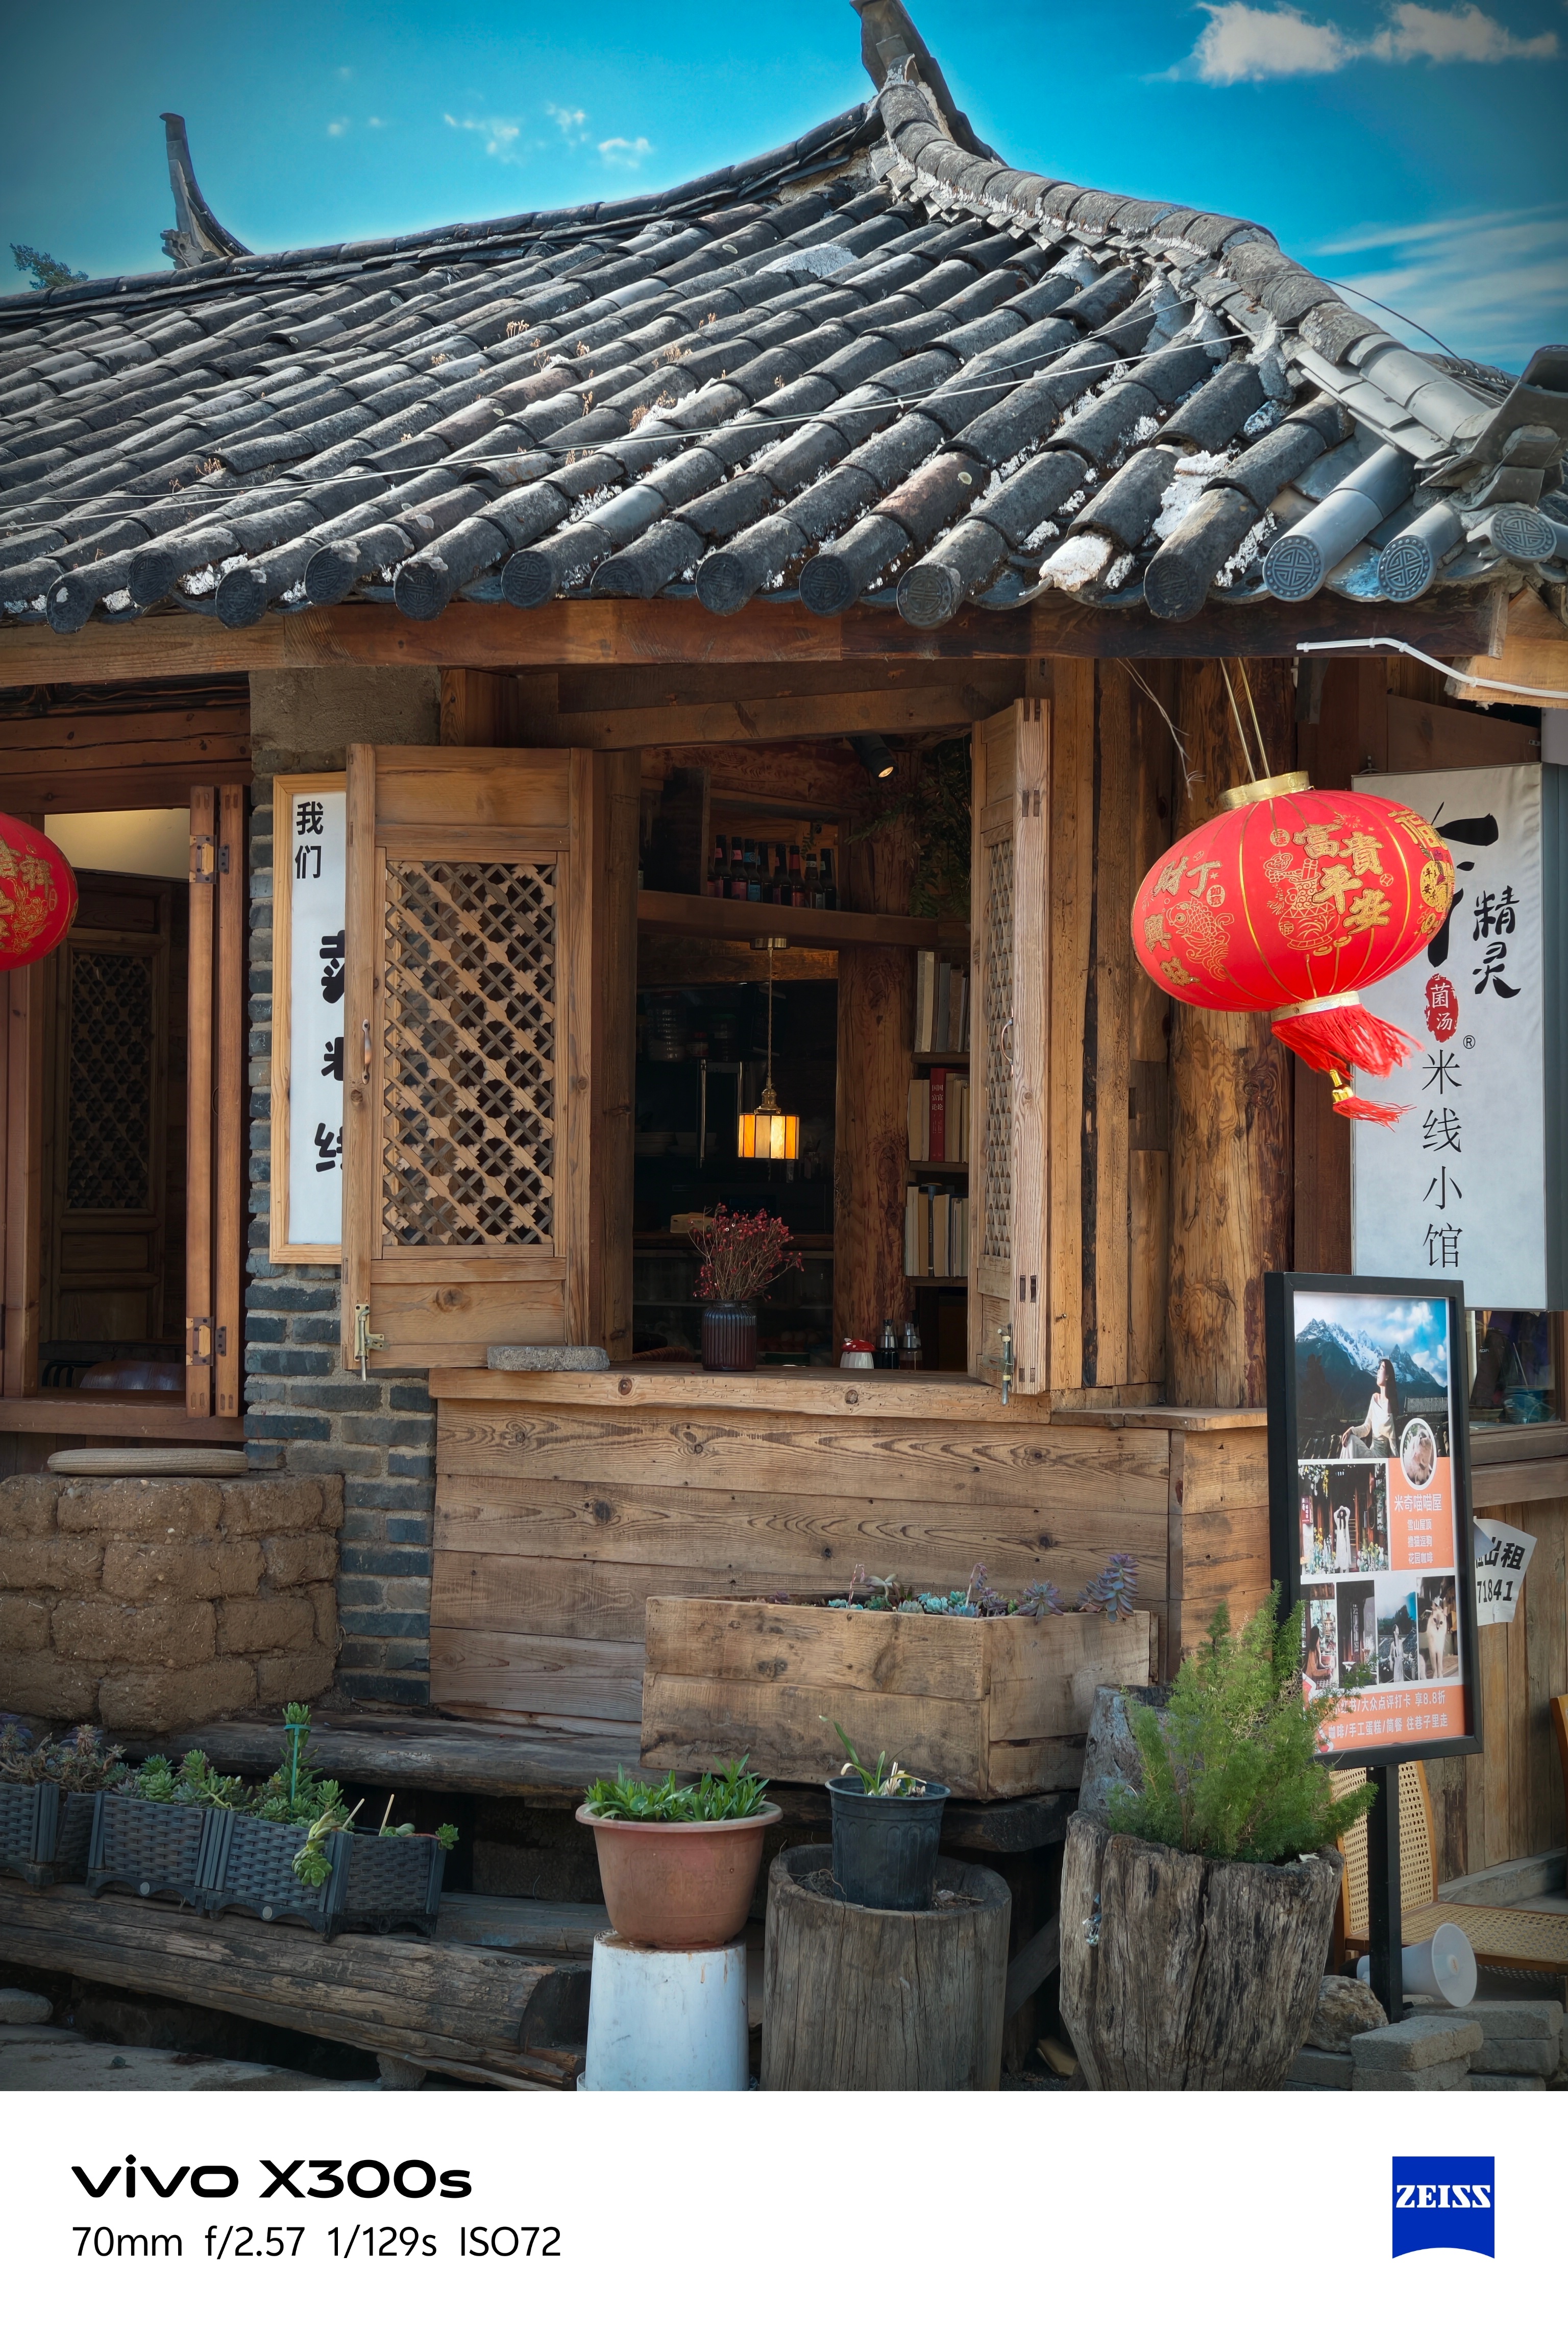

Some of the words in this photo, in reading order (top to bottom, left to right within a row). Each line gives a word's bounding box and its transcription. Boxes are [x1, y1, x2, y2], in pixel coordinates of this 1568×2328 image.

[295, 801, 324, 879] 我们
[1473, 885, 1521, 999] 精灵
[1431, 983, 1453, 1031] 菌汤
[1422, 1049, 1463, 1268] 米线小馆
[1394, 1493, 1442, 1512] 米奇喵喵屋
[1407, 1519, 1432, 1531] 雪山屋顶
[1408, 1552, 1433, 1565] 花园咖啡
[1415, 1690, 1446, 1707] 享8.8折
[1407, 1713, 1448, 1731] 往巷子里走
